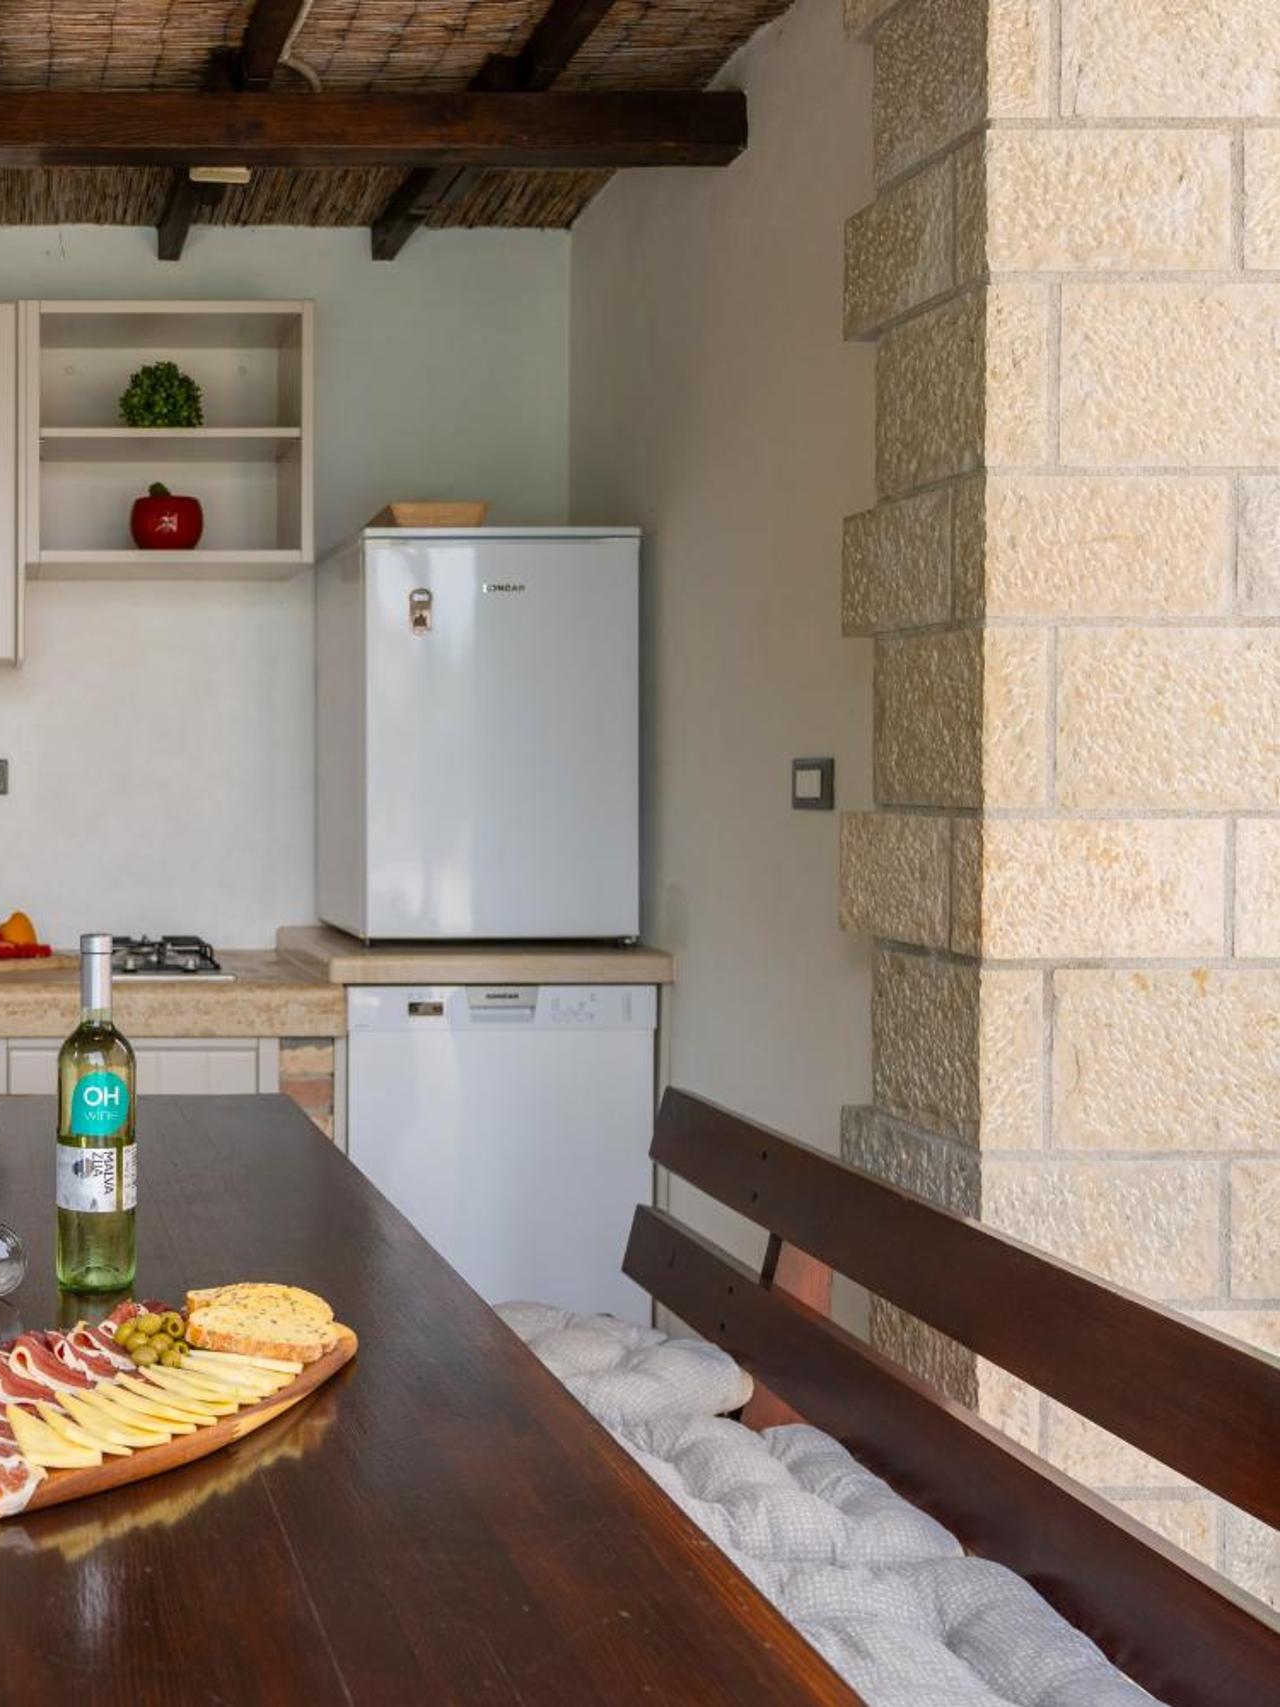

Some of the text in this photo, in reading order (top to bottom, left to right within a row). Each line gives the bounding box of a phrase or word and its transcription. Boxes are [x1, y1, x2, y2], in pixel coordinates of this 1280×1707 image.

[83, 1086, 119, 1107] OH
[84, 1109, 121, 1121] wine
[104, 1152, 114, 1195] MALVA
